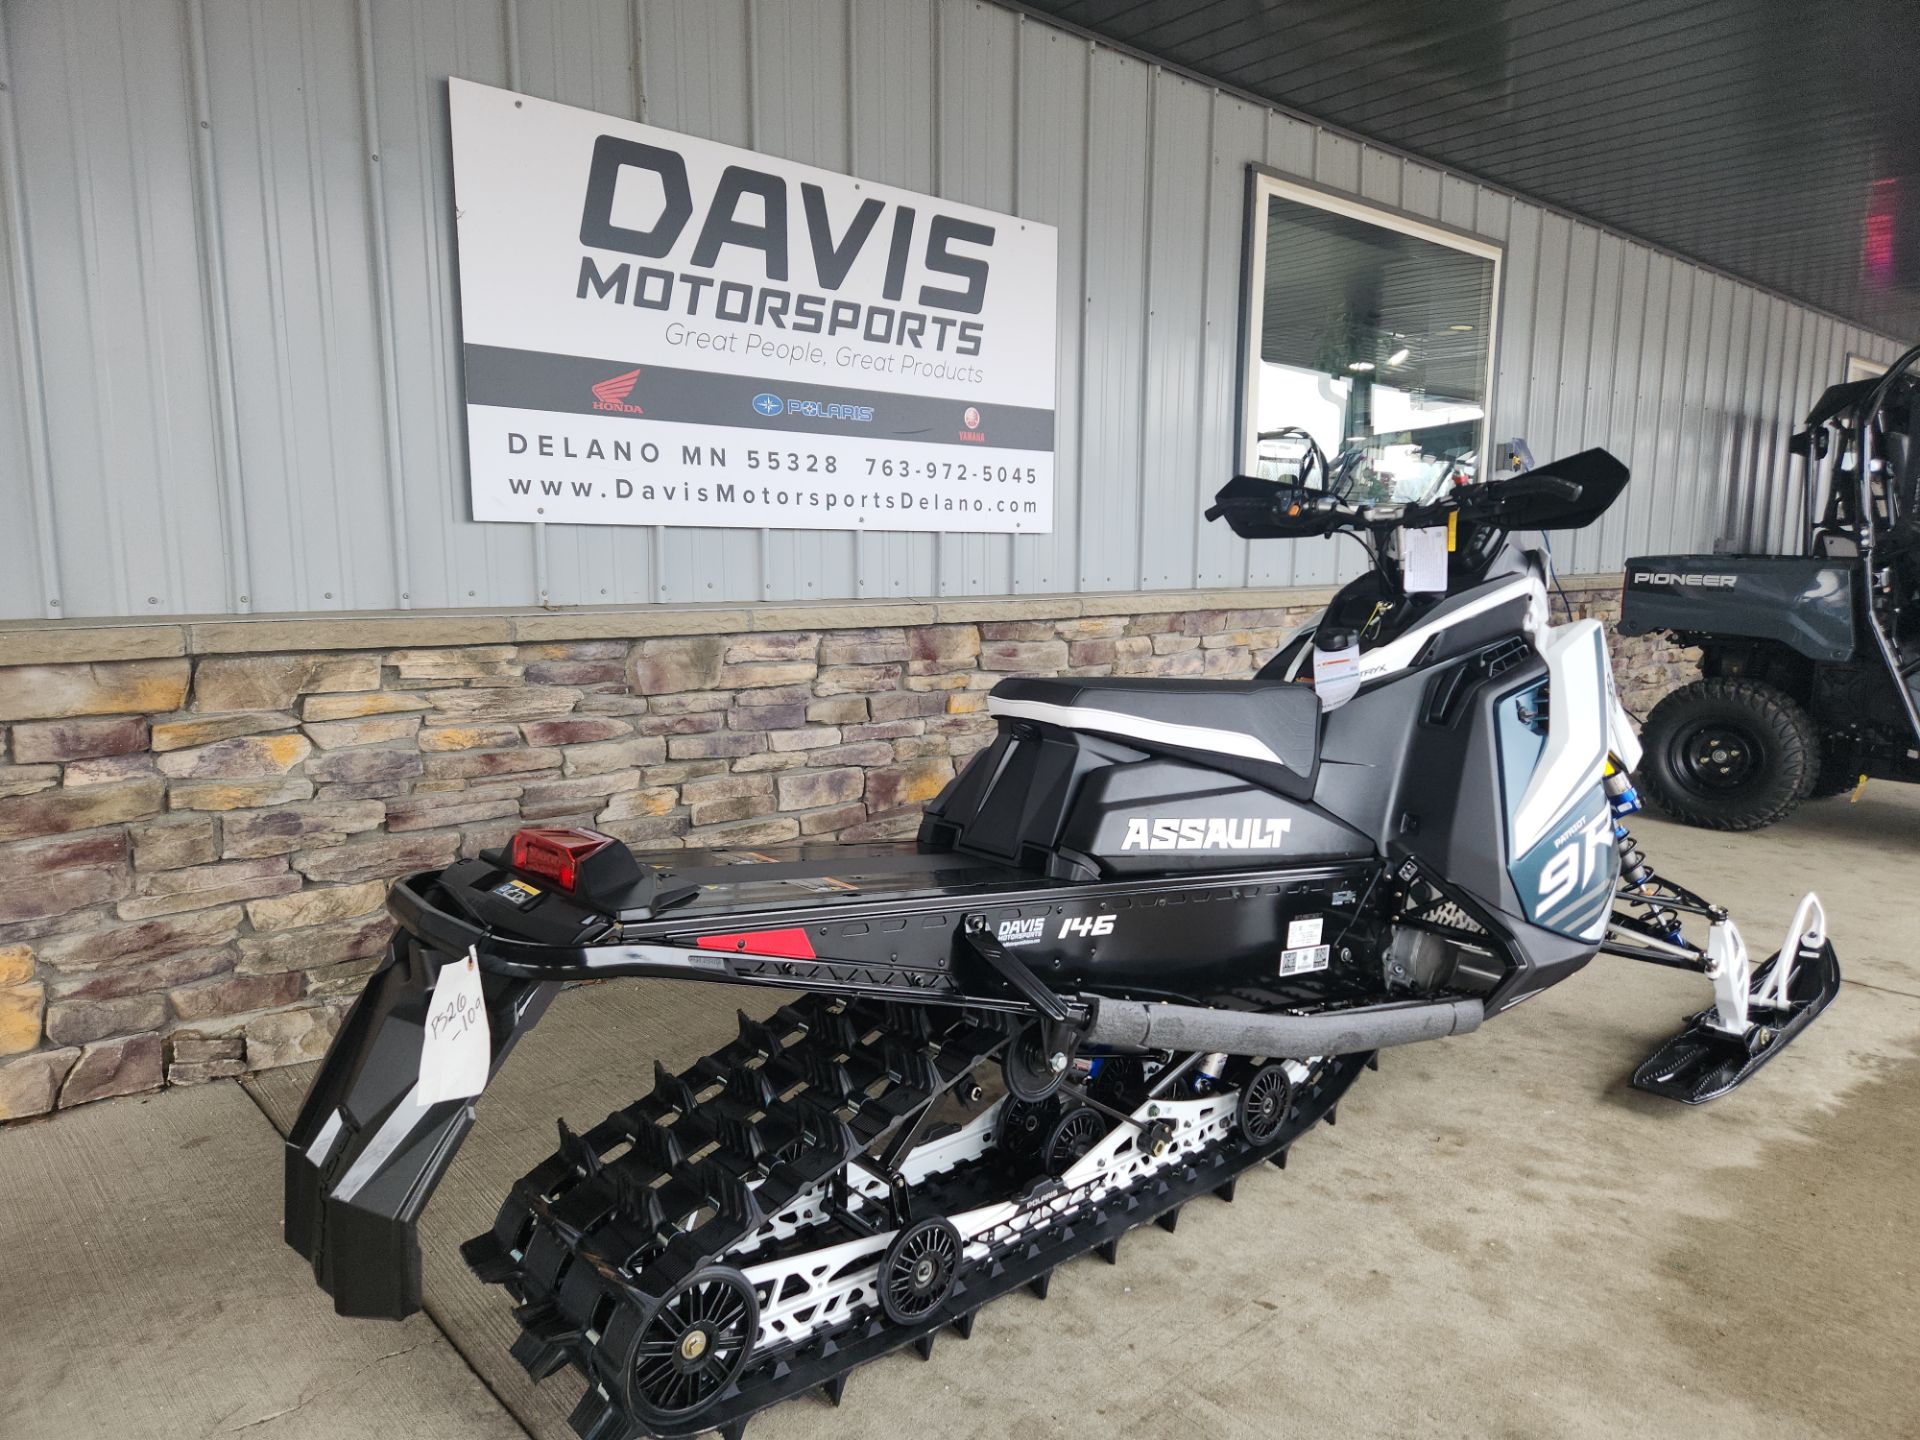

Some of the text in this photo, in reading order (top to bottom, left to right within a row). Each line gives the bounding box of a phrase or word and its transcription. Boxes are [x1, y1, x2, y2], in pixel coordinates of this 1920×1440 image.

[579, 134, 996, 314] DAVIS
[576, 256, 984, 356] MOTORSPORTS
[665, 322, 984, 383] Great People, Great Products
[592, 401, 644, 414] HONDA
[787, 399, 875, 422] POLARIS
[959, 431, 985, 442] YAMAHA
[507, 432, 1036, 483] DELANO MN 55328 763-972-5045
[508, 478, 1037, 513] www.DavisMotorsportsDelano.com
[1634, 573, 1738, 588] PIONEER
[1121, 818, 1291, 850] ASSAULT
[1553, 815, 1587, 848] PATRIOT
[1535, 802, 1615, 919] 9R
[998, 917, 1046, 936] DAVIS
[1058, 914, 1117, 939] 146
